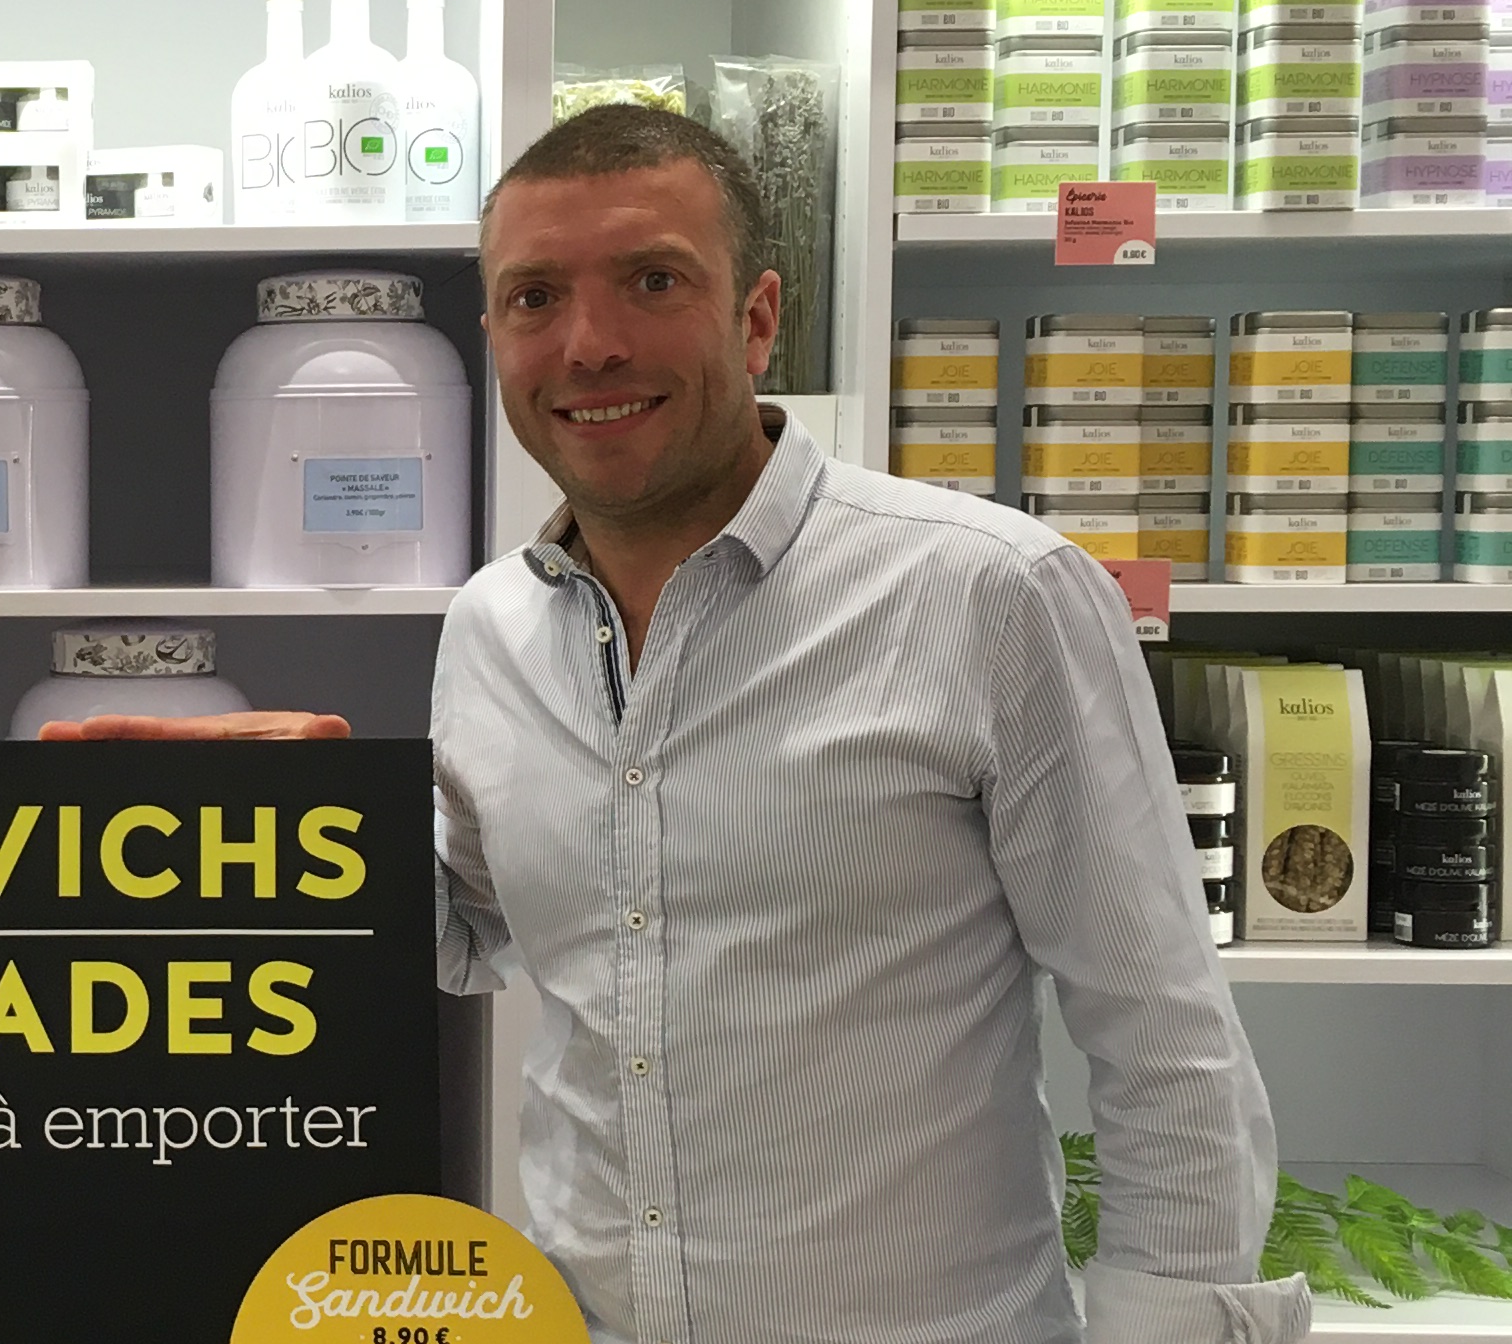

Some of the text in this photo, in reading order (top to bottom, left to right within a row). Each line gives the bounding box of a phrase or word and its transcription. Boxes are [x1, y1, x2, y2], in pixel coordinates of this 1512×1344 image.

[1301, 48, 1331, 58] kalios
[908, 78, 990, 92] HARMONIE
[1146, 78, 1227, 92] HARMONIE
[1273, 72, 1356, 86] HARMONIE
[1409, 72, 1481, 86] HYPNOSE
[329, 83, 372, 99] kalios
[1018, 82, 1097, 95] HARMONIE
[305, 117, 398, 177] BIO
[1299, 140, 1329, 151] kalios
[902, 169, 984, 183] HARMONIE
[1141, 169, 1223, 182] HARMONIE
[1271, 164, 1354, 179] HARMONIE
[1405, 164, 1478, 178] HYPNOSE
[1292, 336, 1322, 346] kalios
[1391, 336, 1420, 347] kalios
[940, 364, 970, 377] JOIE
[1086, 362, 1117, 376] JOIE
[1158, 363, 1189, 376] JOIE
[1291, 359, 1323, 373] JOIE
[1082, 428, 1111, 438] kalios
[1291, 426, 1321, 437] kalios
[1388, 426, 1417, 437] kalios
[939, 452, 970, 465] JOIE
[1081, 452, 1113, 465] JOIE
[1154, 451, 1185, 464] JOIE
[1289, 450, 1321, 464] JOIE
[359, 474, 369, 482] DE
[370, 473, 400, 482] SAVEUR
[1080, 518, 1108, 528] kalios
[1154, 516, 1181, 526] kalios
[1288, 517, 1317, 528] kalios
[1383, 516, 1412, 525] kalios
[1153, 538, 1183, 552] JOIE
[1286, 541, 1318, 555] JOIE
[1279, 698, 1335, 715] kalios
[1270, 752, 1348, 767] GRESSINS
[1453, 789, 1482, 799] kalios
[1442, 854, 1472, 864] kalios
[44, 1095, 377, 1166] emporter
[329, 1239, 488, 1277] FORMULE
[287, 1271, 533, 1330] Sandwich
